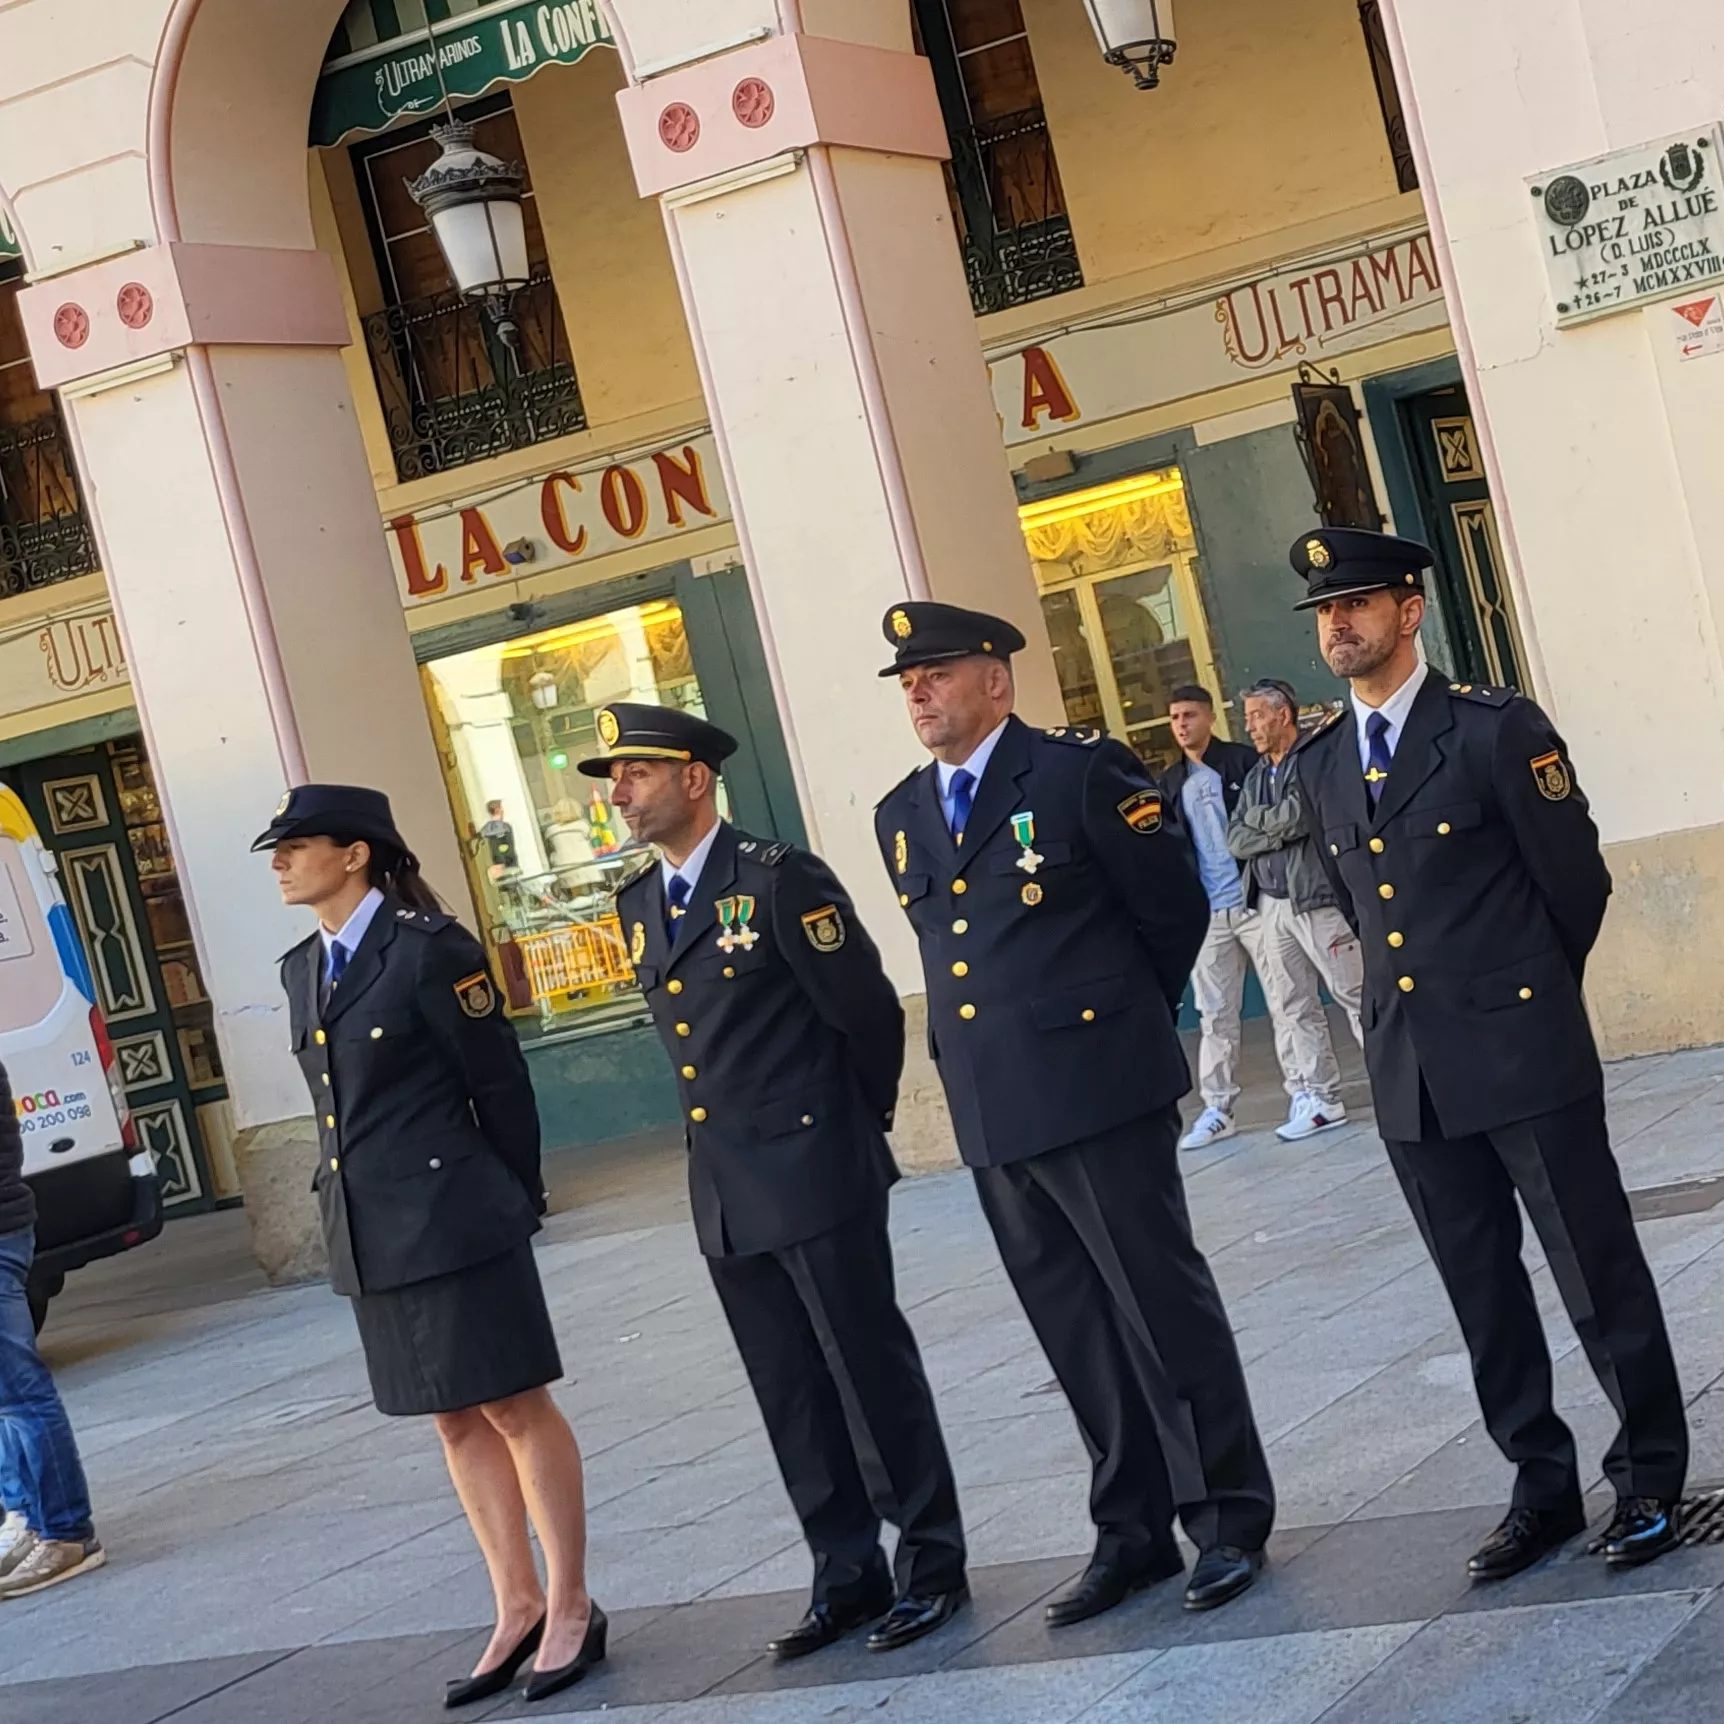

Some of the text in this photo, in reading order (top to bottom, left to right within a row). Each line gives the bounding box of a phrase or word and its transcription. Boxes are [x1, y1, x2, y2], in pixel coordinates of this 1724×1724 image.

[382, 35, 483, 97] ULTRAMARINOS
[500, 19, 537, 71] LA
[1590, 170, 1658, 201] PLAZA
[1618, 196, 1640, 212] DE
[1549, 186, 1718, 257] LÓPEZ ALLUÉ
[1628, 226, 1675, 256] LUIS)
[1640, 237, 1712, 273] MDCCCLX
[1633, 255, 1722, 294] MCMXXVIII
[390, 445, 717, 598] LA CON
[70, 1050, 91, 1067] 124
[37, 1111, 66, 1129] 200
[67, 1104, 92, 1121] 098
